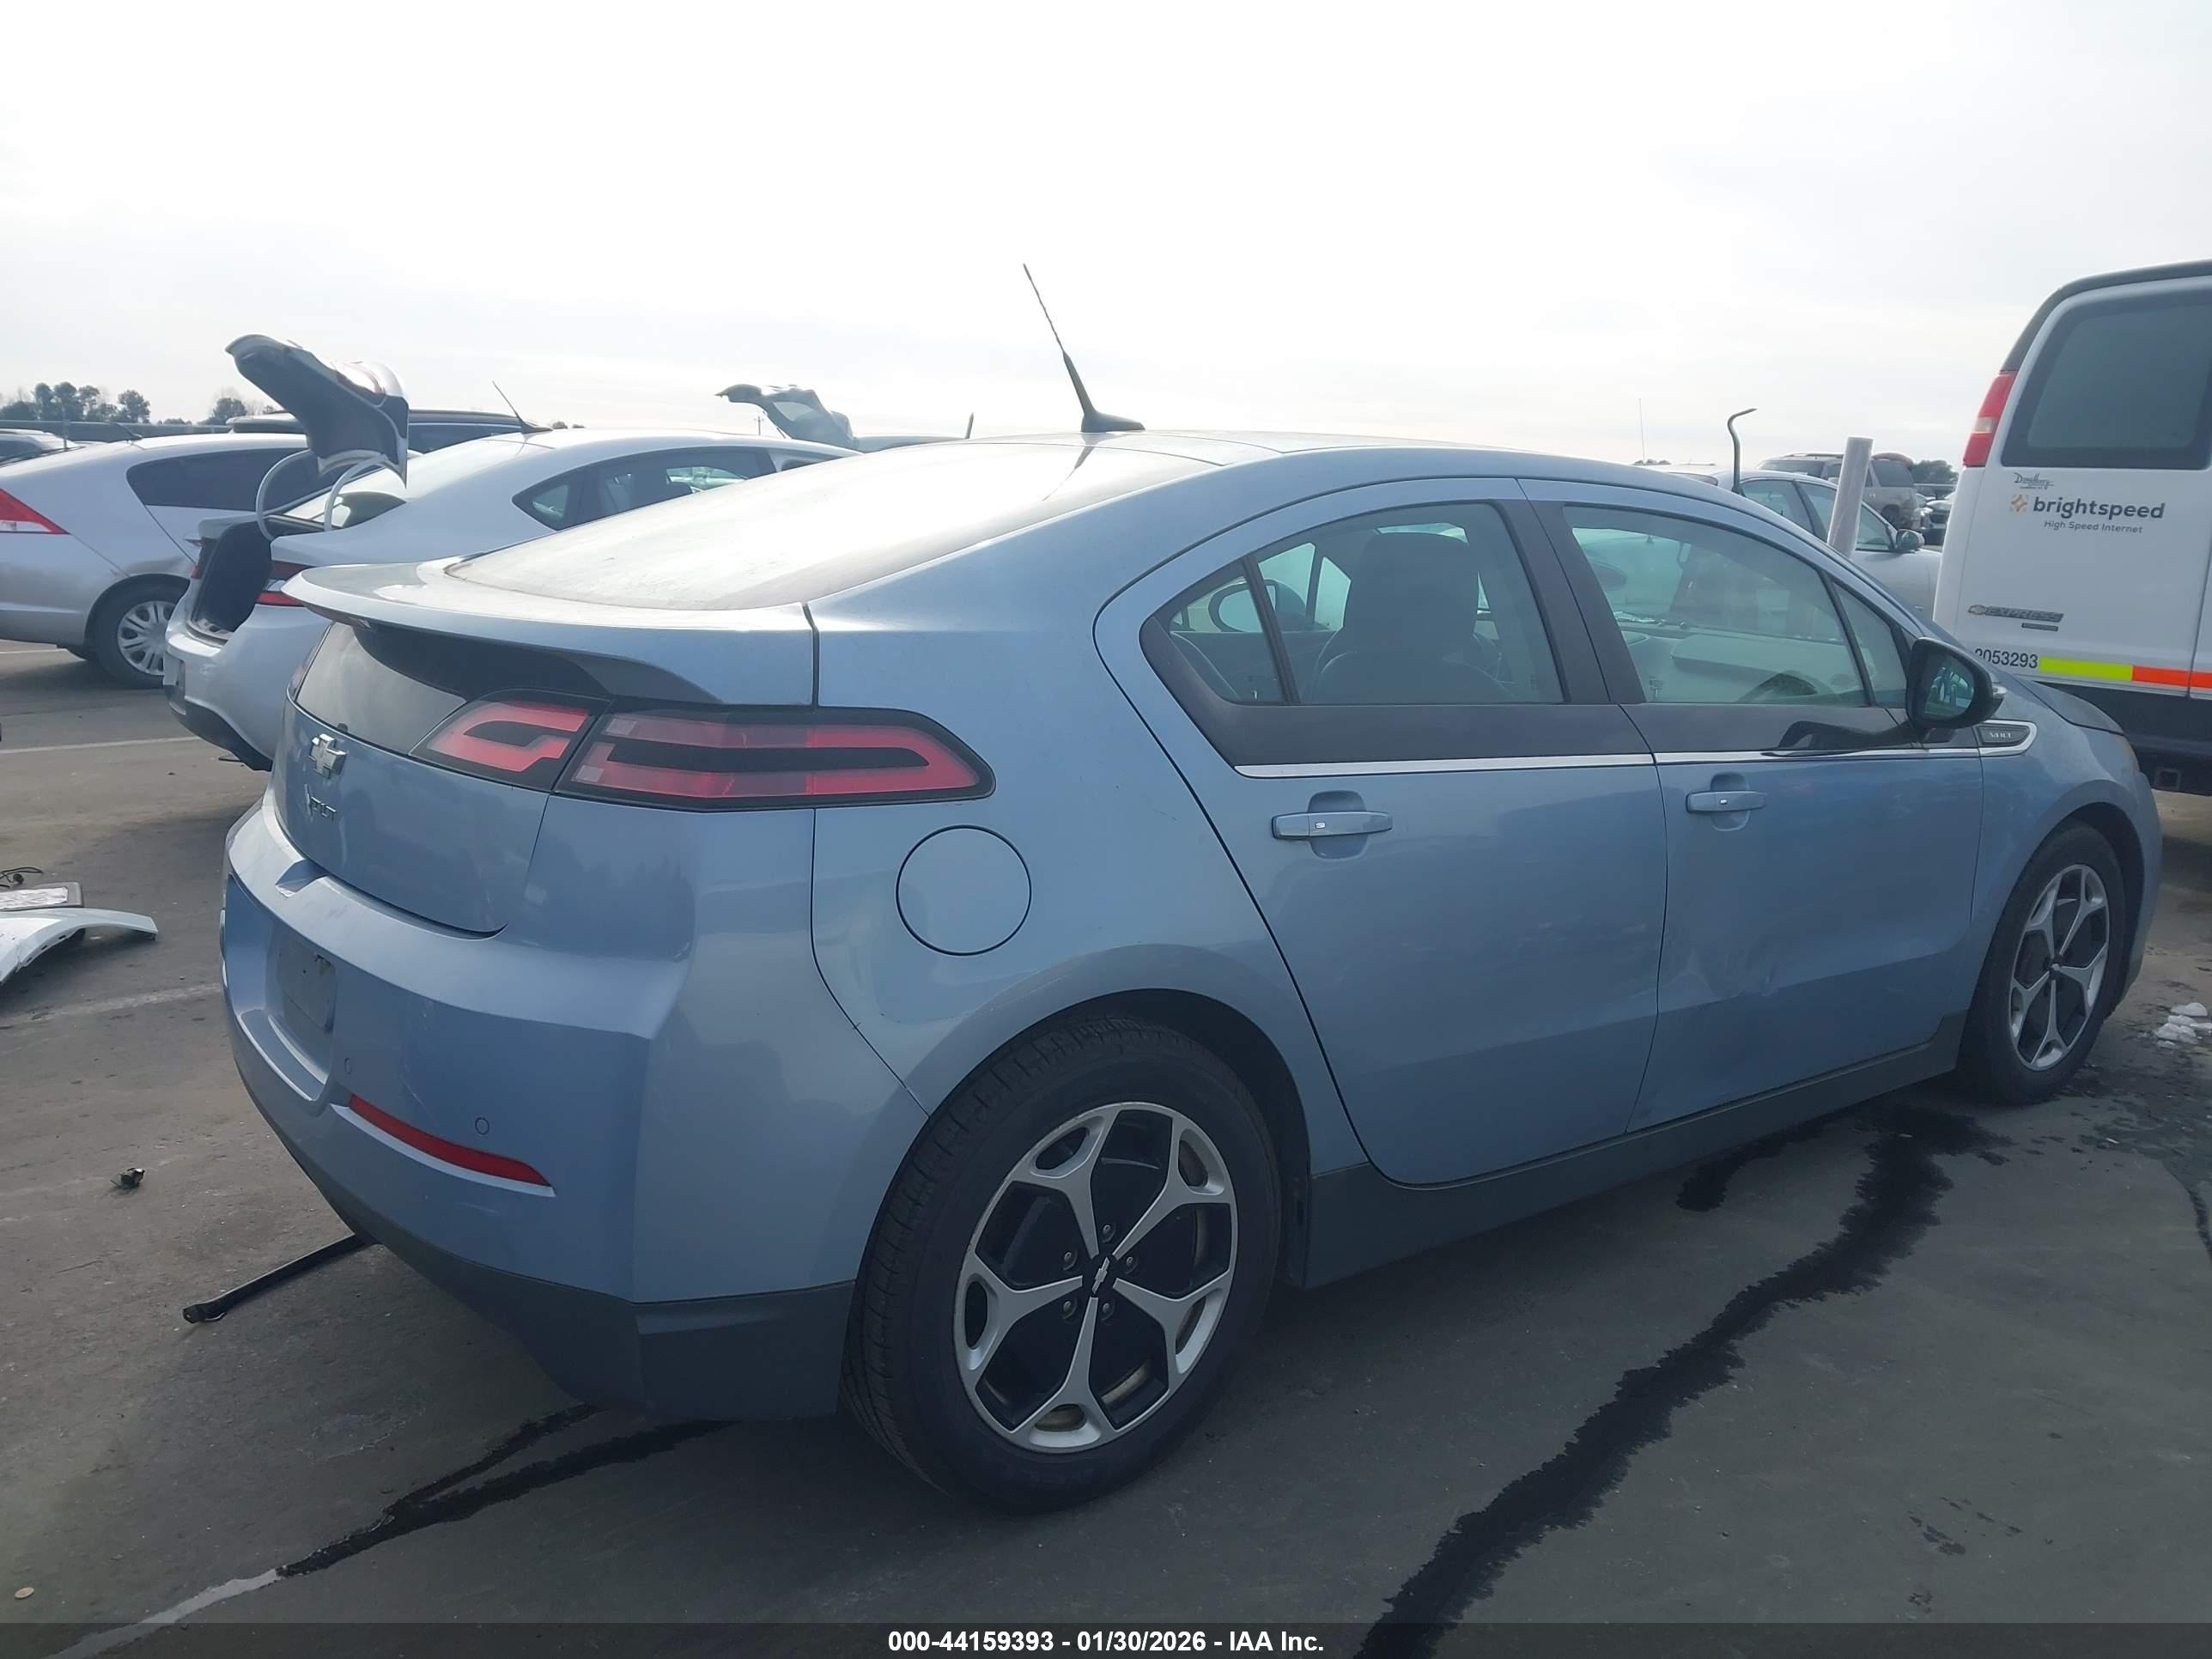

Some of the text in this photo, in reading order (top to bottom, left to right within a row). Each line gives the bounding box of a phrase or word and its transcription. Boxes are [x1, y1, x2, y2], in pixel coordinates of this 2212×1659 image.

[2033, 496, 2166, 520] brightspeed
[2044, 520, 2143, 534] High Speed Internet
[1988, 606, 2061, 622] EXPRESS
